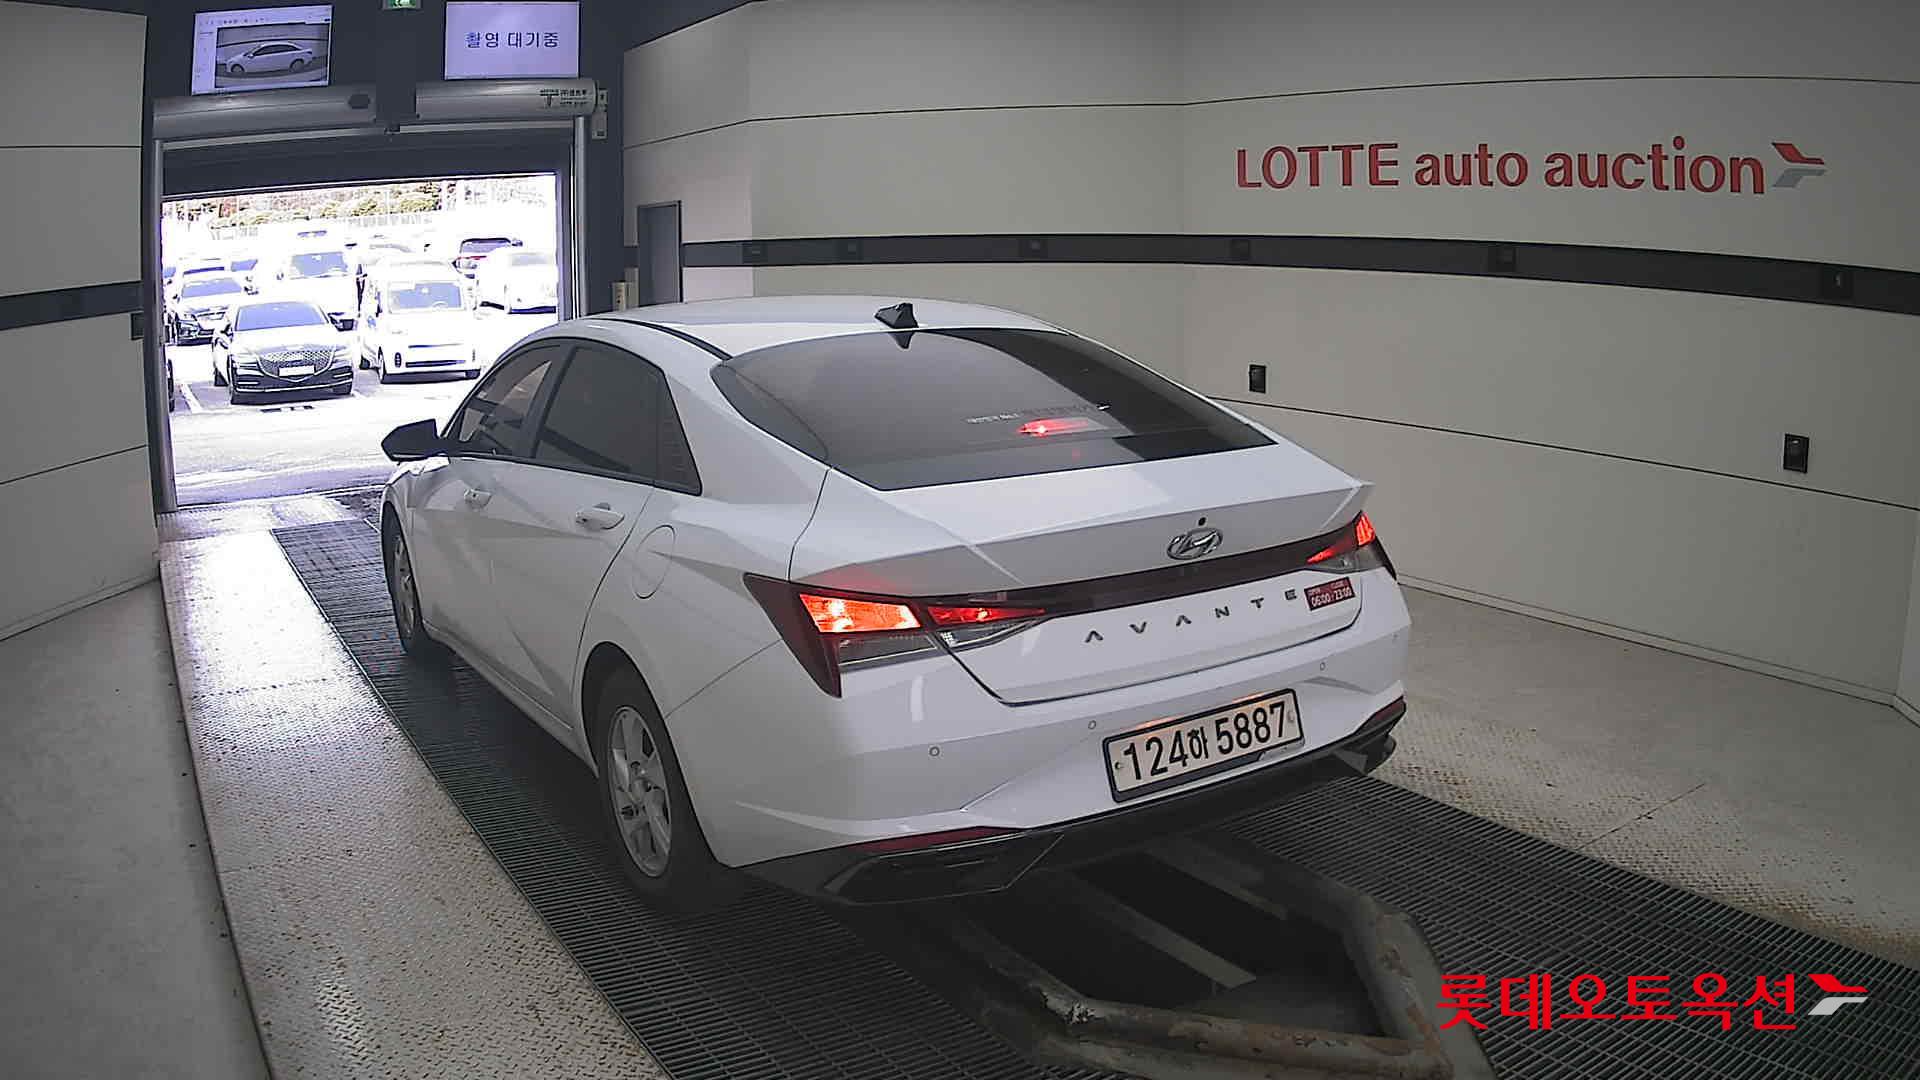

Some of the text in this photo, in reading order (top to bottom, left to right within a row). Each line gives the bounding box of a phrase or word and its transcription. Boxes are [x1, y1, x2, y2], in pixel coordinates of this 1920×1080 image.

[466, 32, 559, 49] 촬영 대기중
[1237, 135, 1765, 194] LOTTE auto auction
[1084, 589, 1298, 643] AVANTE
[1123, 701, 1285, 780] 124하 5887
